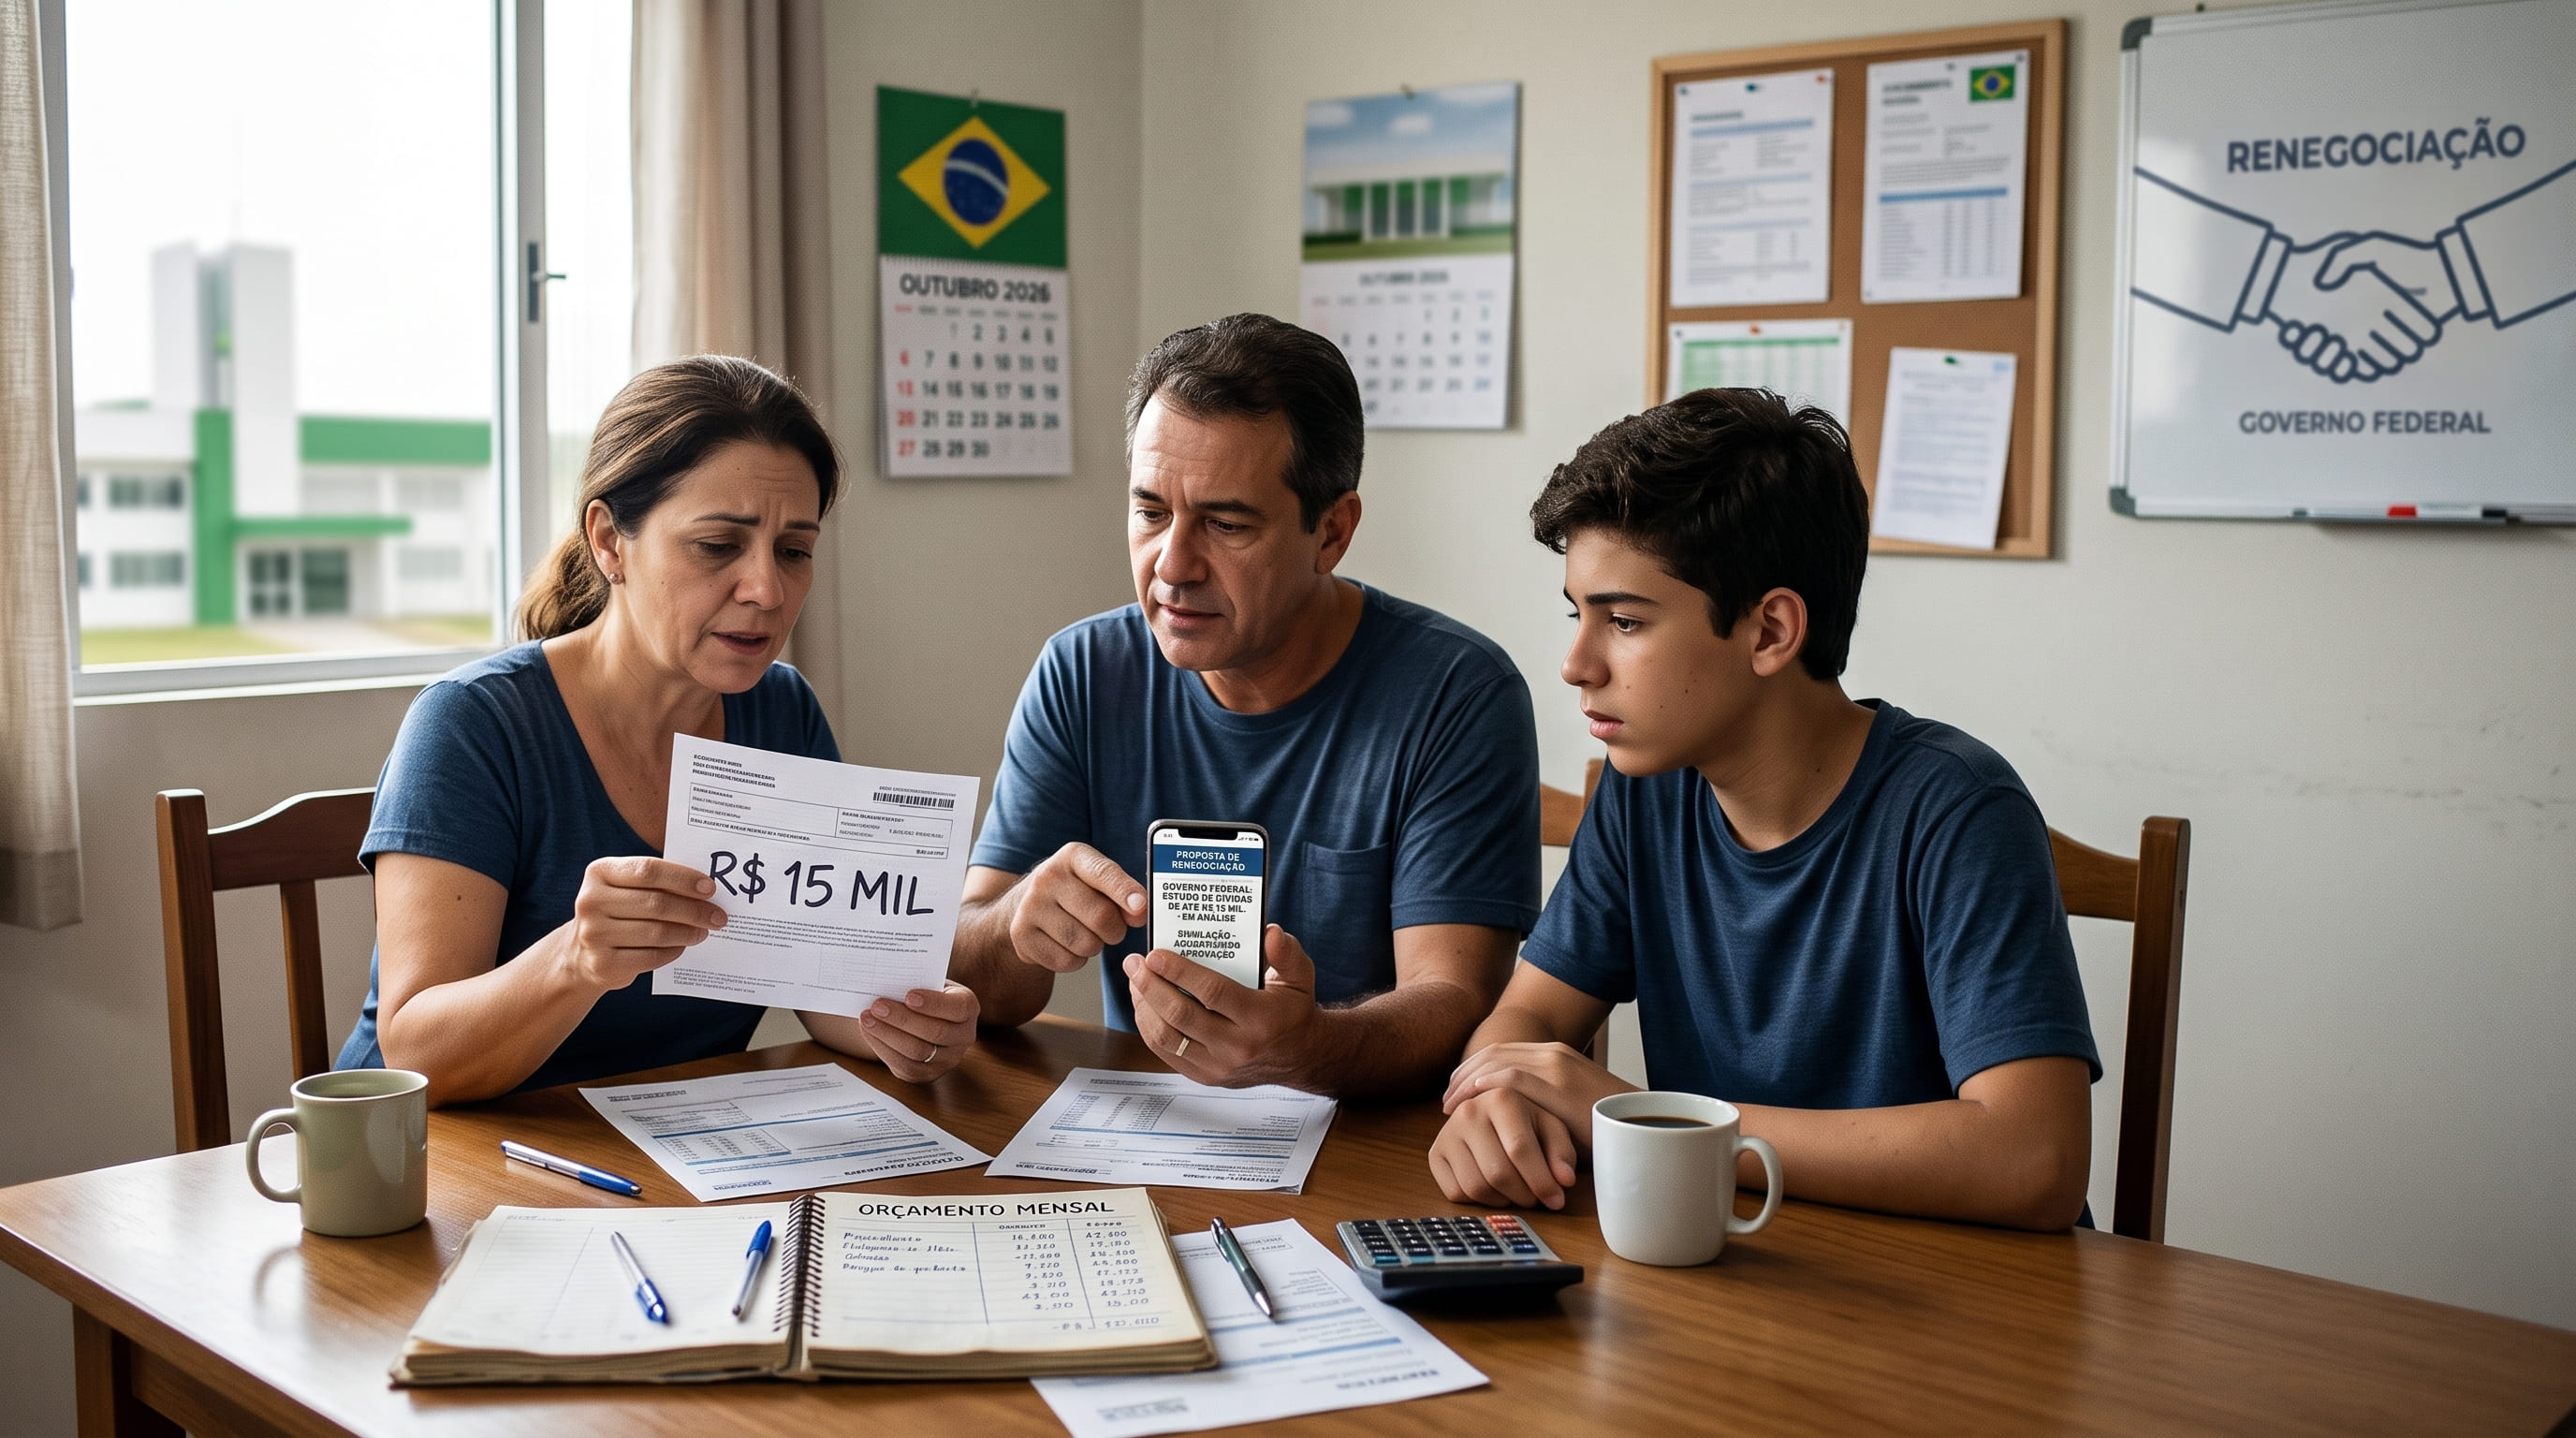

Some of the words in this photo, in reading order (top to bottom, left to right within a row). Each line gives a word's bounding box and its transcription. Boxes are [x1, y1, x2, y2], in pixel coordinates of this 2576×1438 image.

[2227, 118, 2525, 172] RENEGOCIAÇÃO
[900, 273, 999, 300] OUTUBRO
[2239, 411, 2364, 434] GOVERNO
[2373, 411, 2491, 434] FEDERAL
[1176, 850, 1225, 860] PROPOSTA
[1227, 853, 1240, 861] DE
[710, 851, 766, 904] R$
[784, 860, 834, 907] 15
[850, 870, 934, 916] MIL
[1163, 883, 1208, 892] GOVERNO
[858, 1204, 1005, 1218] ORÇAMENTO
[1017, 1201, 1115, 1215] MENSAL
